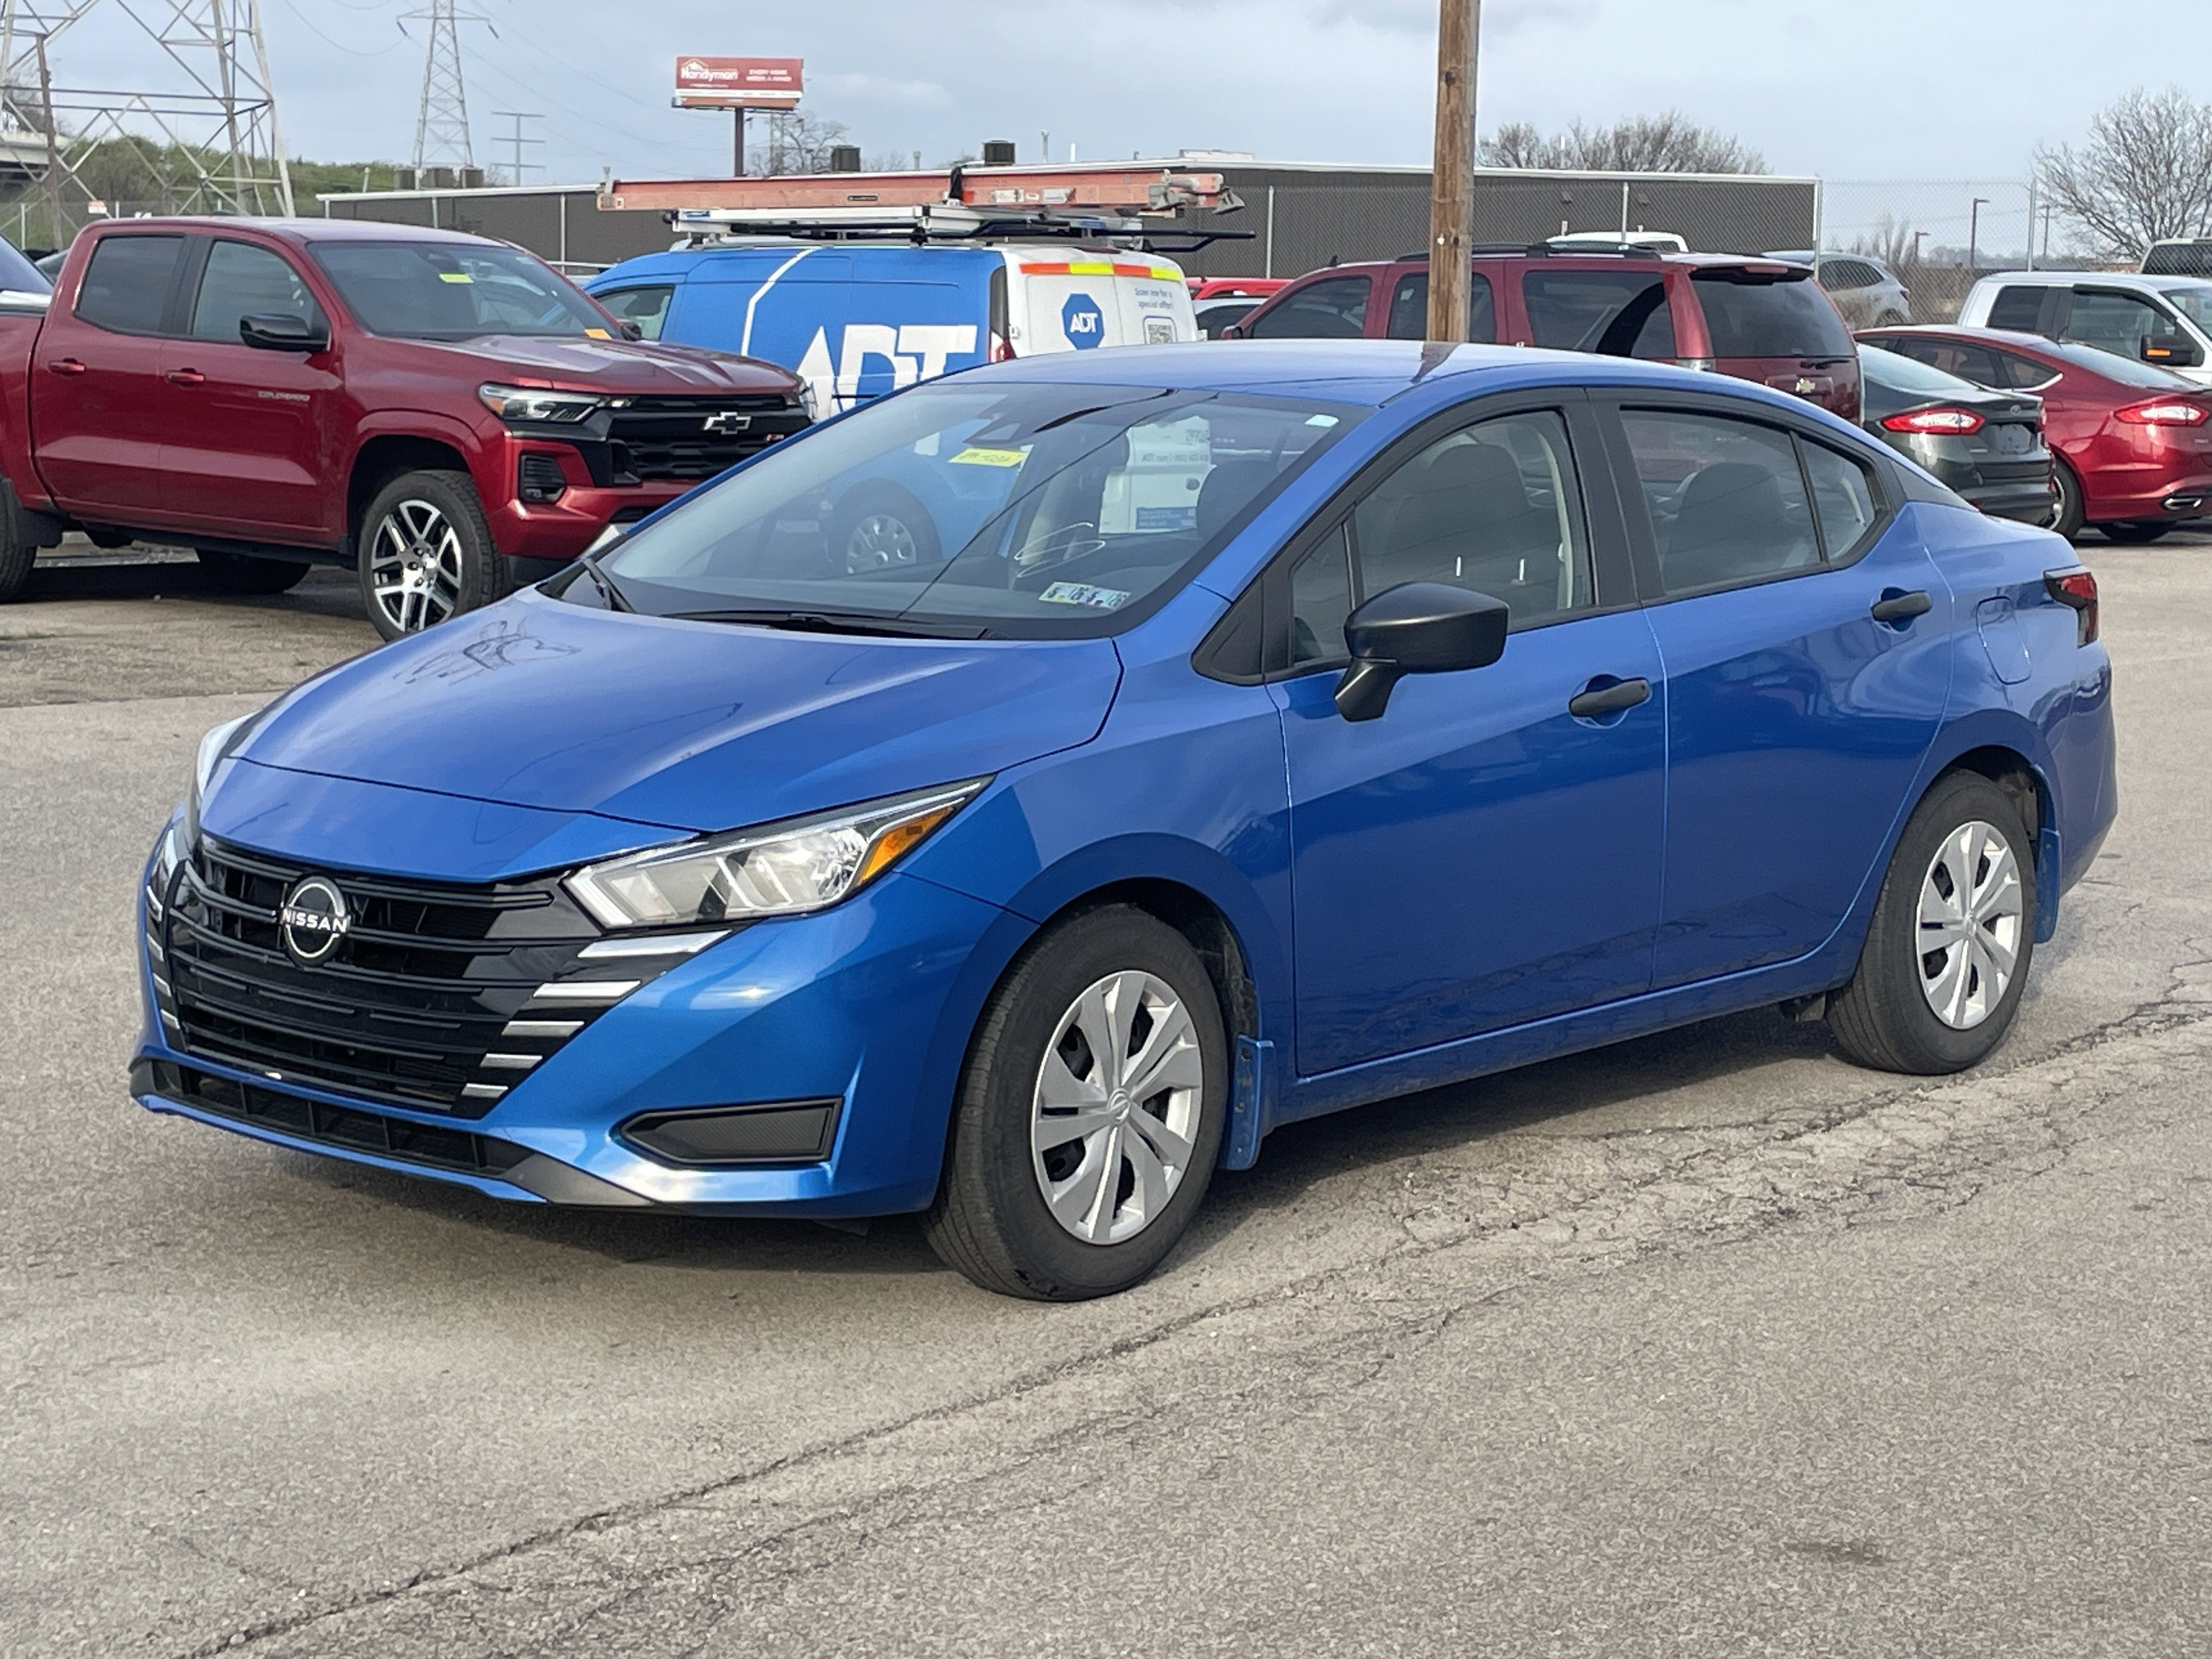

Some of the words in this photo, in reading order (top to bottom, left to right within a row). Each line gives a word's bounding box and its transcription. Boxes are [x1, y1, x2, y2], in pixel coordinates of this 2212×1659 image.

[1070, 313, 1098, 333] ADT
[796, 324, 978, 421] ADT
[283, 909, 347, 933] NISSAN
